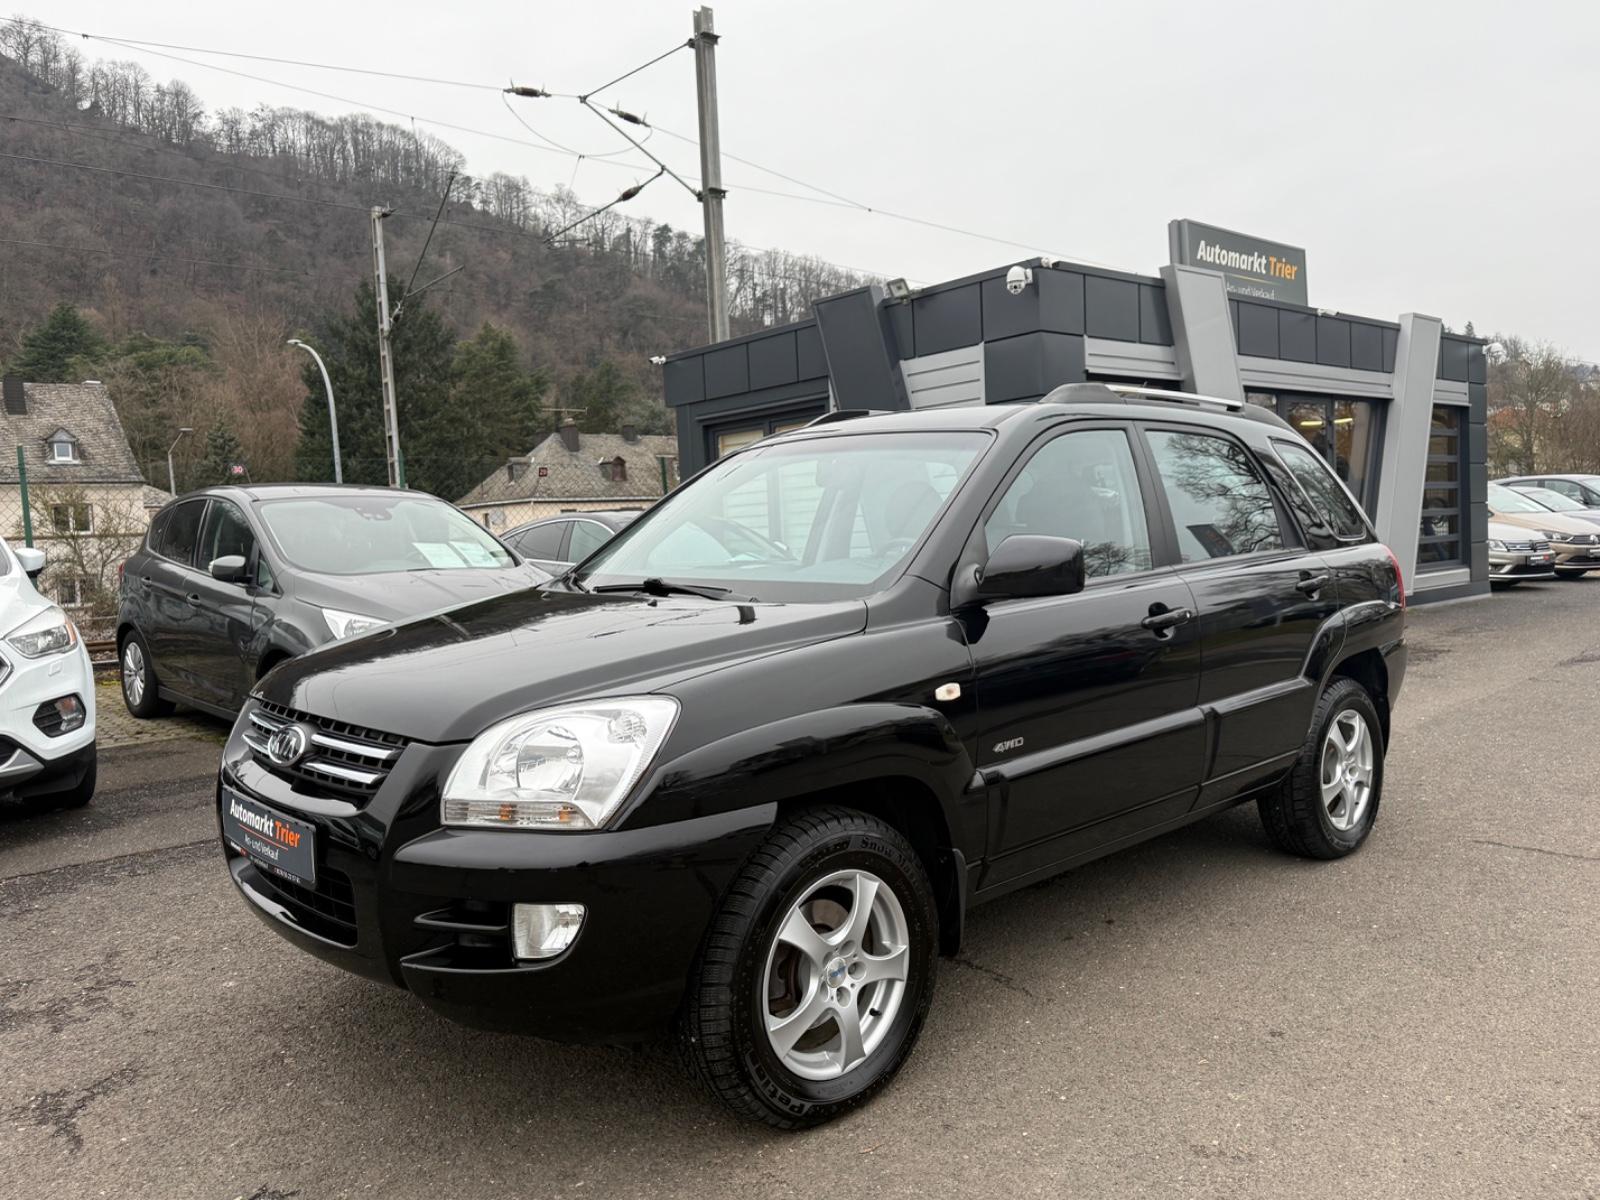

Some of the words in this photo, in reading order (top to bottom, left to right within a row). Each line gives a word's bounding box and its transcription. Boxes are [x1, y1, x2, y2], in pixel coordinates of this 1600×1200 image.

[1197, 240, 1267, 274] Automarkt
[1269, 256, 1298, 280] Trier
[992, 736, 1024, 752] 4WD
[230, 799, 274, 837] Automarkt
[274, 821, 300, 848] Trier
[252, 839, 261, 852] und
[261, 842, 279, 860] Verkauf
